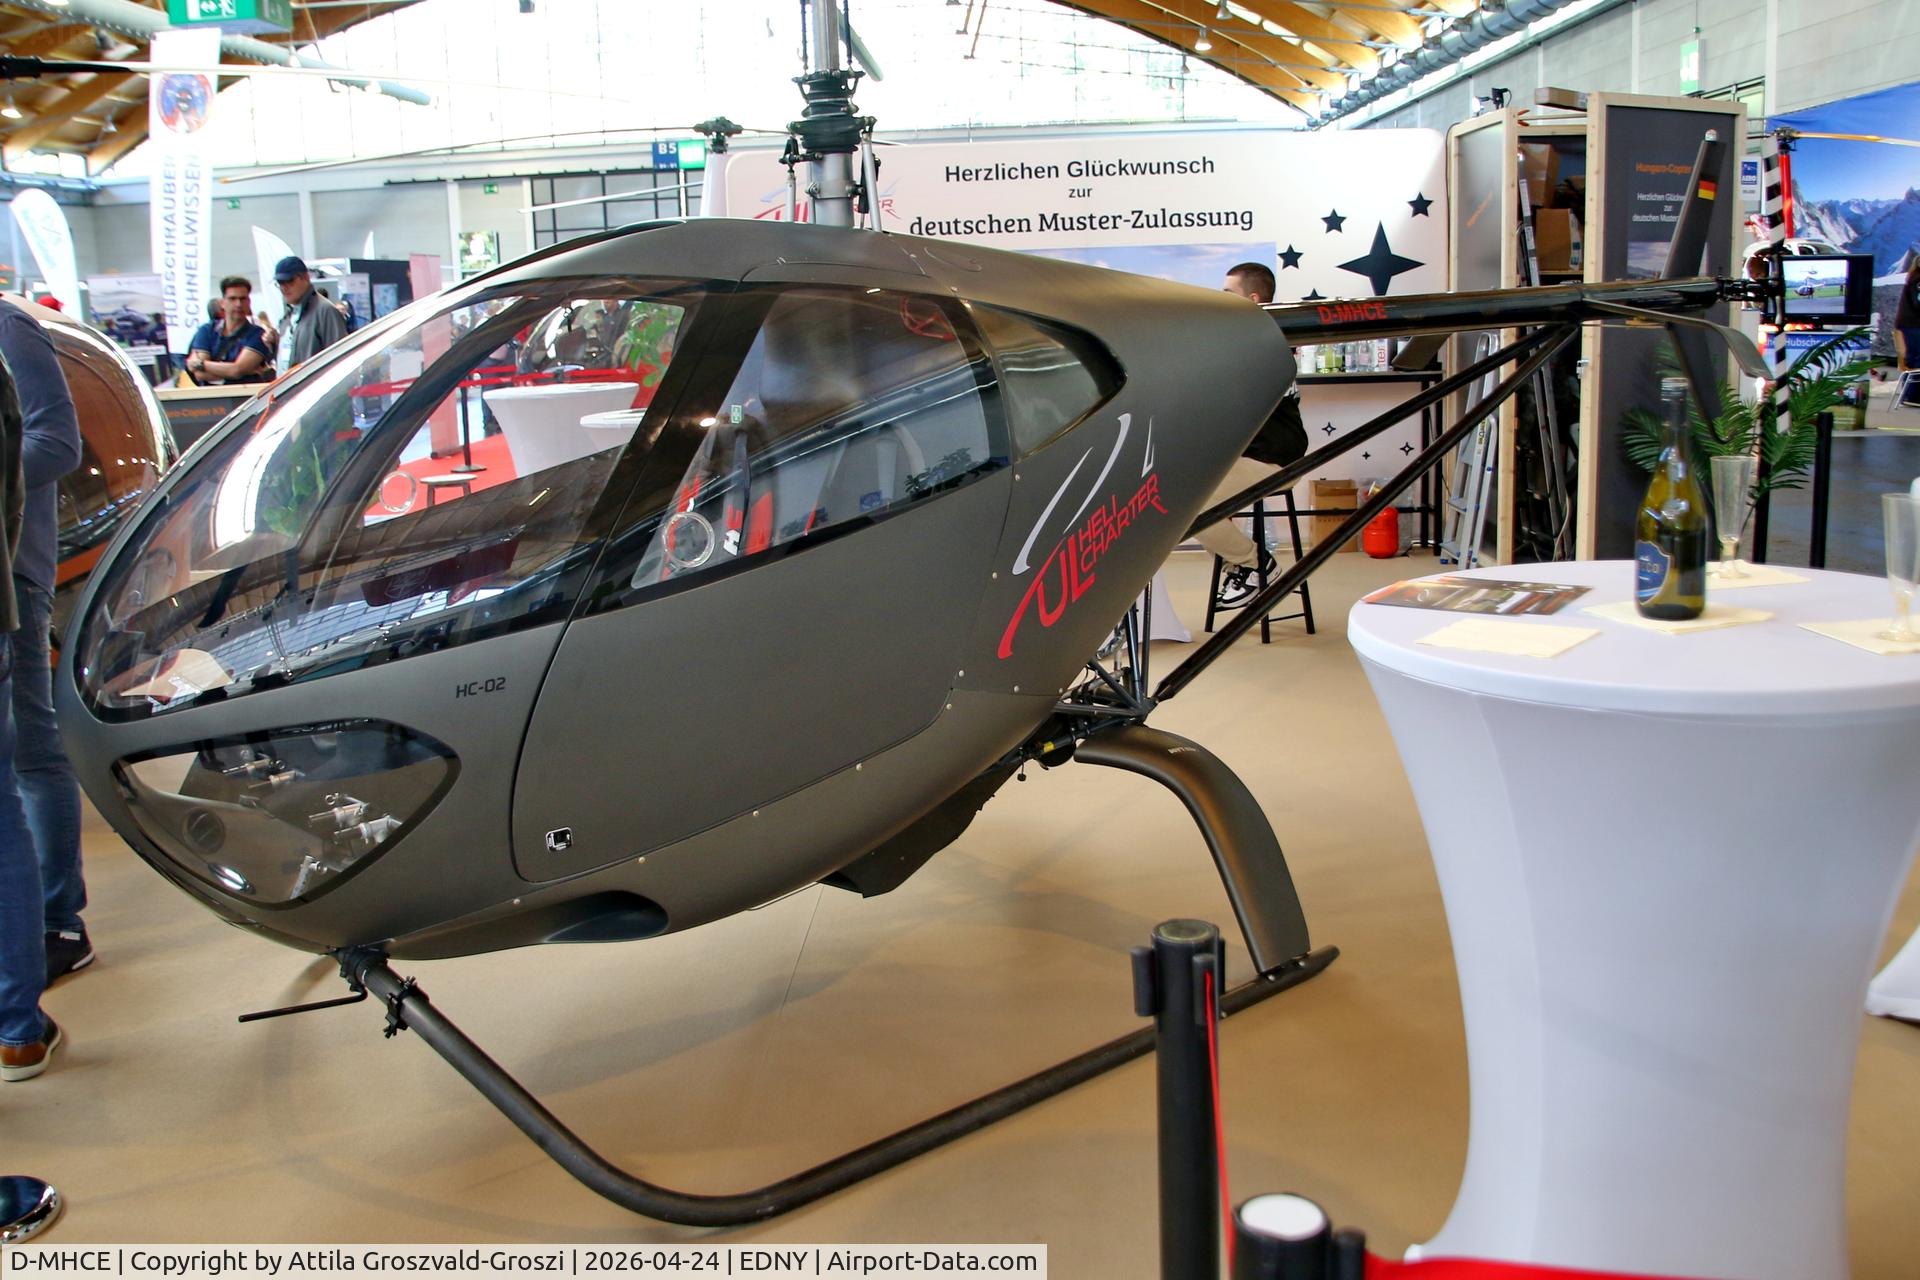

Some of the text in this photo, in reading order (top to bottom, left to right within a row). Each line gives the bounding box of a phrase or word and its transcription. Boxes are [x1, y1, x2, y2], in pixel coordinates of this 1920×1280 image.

[944, 156, 1215, 182] Herzlichen Glückwunsch
[1068, 186, 1093, 198] zur
[910, 208, 1253, 236] deutschen Muster-Zulassung
[1317, 302, 1389, 325] D-MHCE
[1079, 494, 1118, 552] HELI
[1081, 473, 1168, 574] CHARTER
[456, 676, 507, 699] HC-02
